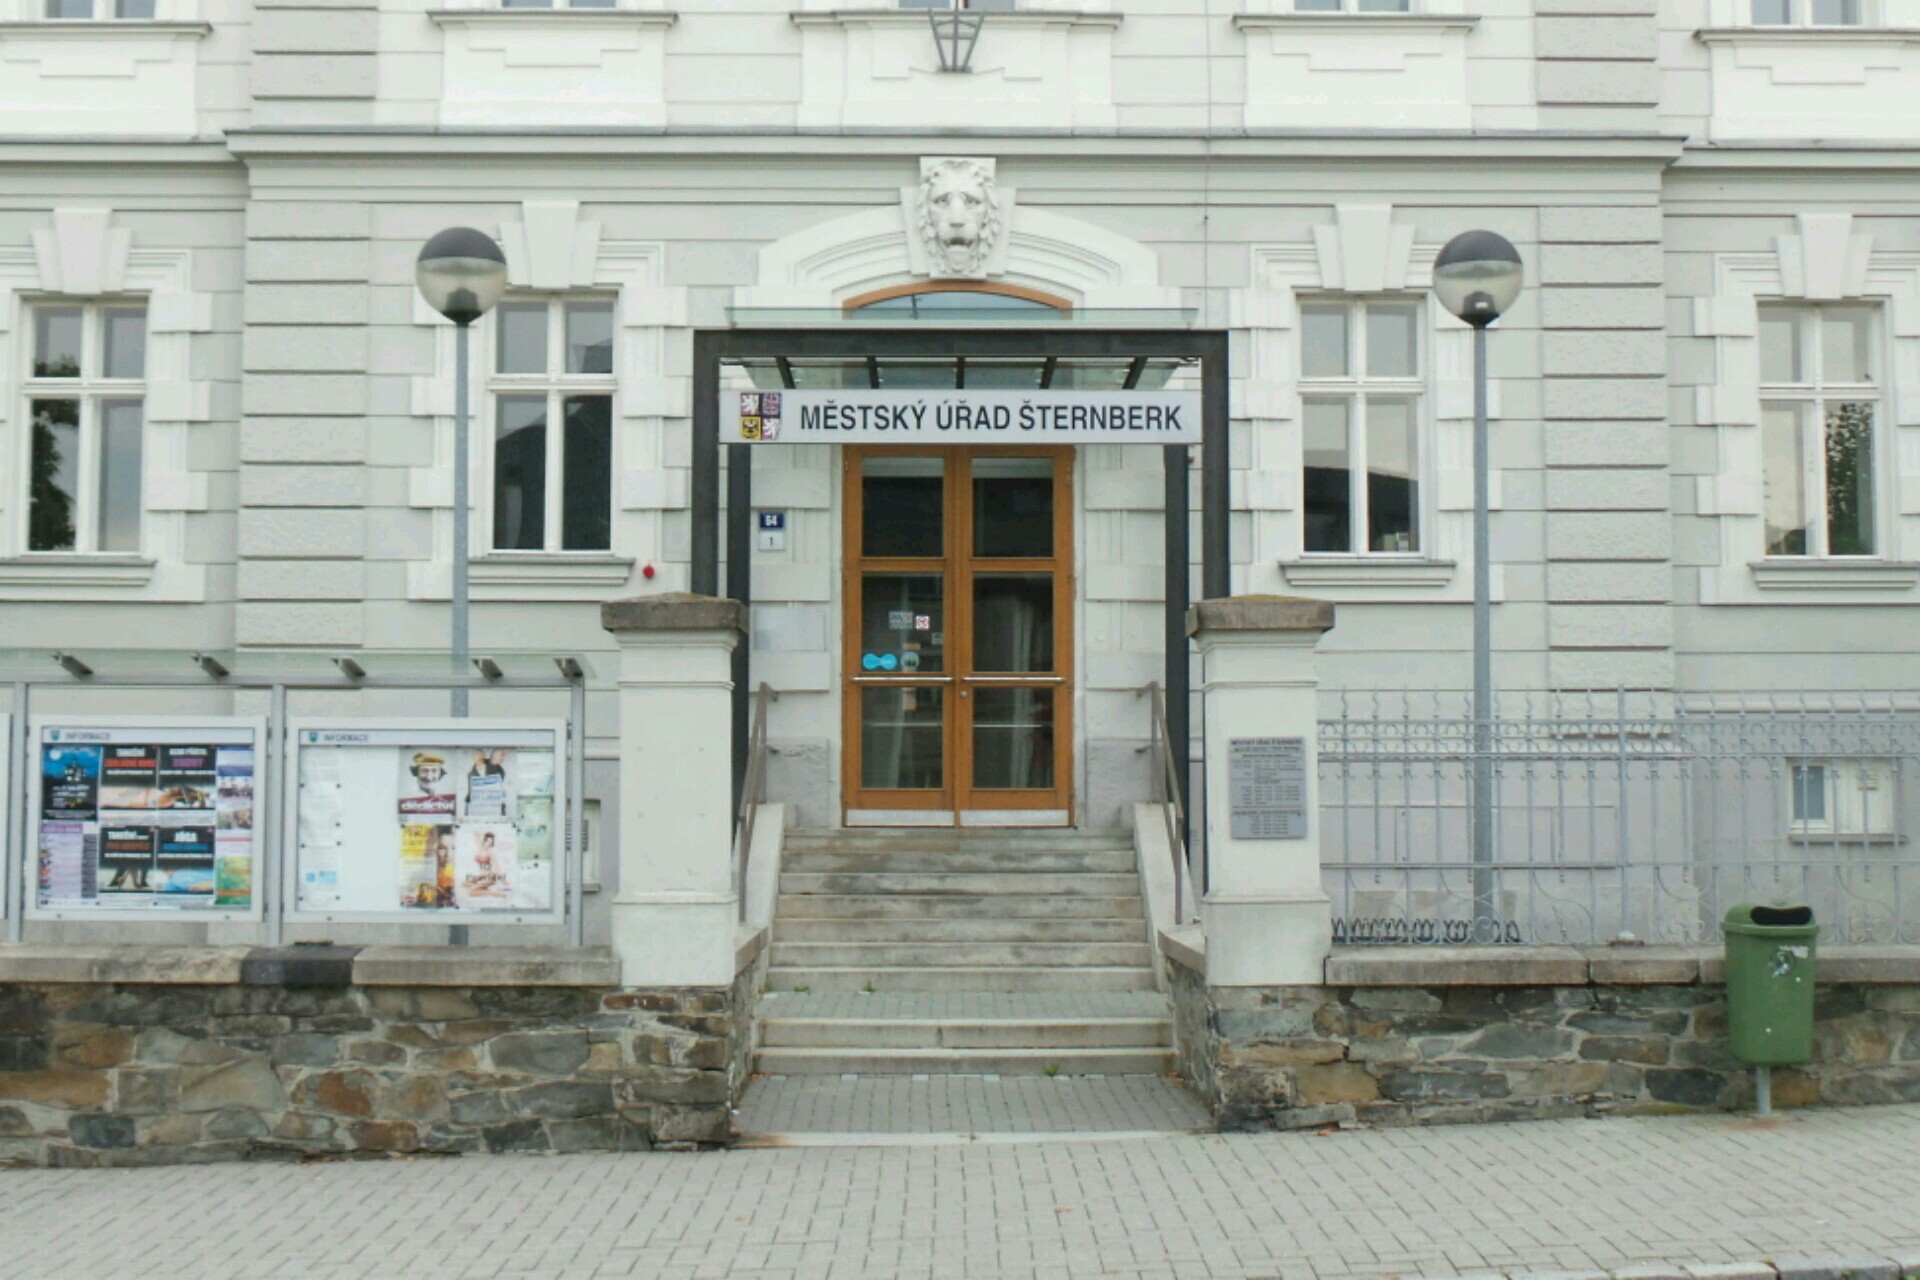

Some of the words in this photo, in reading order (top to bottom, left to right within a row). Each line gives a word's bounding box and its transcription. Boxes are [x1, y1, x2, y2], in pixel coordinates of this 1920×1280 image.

[800, 399, 927, 430] MĚSTSKÝ
[935, 399, 1011, 430] ÚŘAD
[1018, 399, 1182, 430] ŠTERNBERK
[65, 732, 111, 740] INFORMACE
[323, 734, 369, 742] INFORMACE
